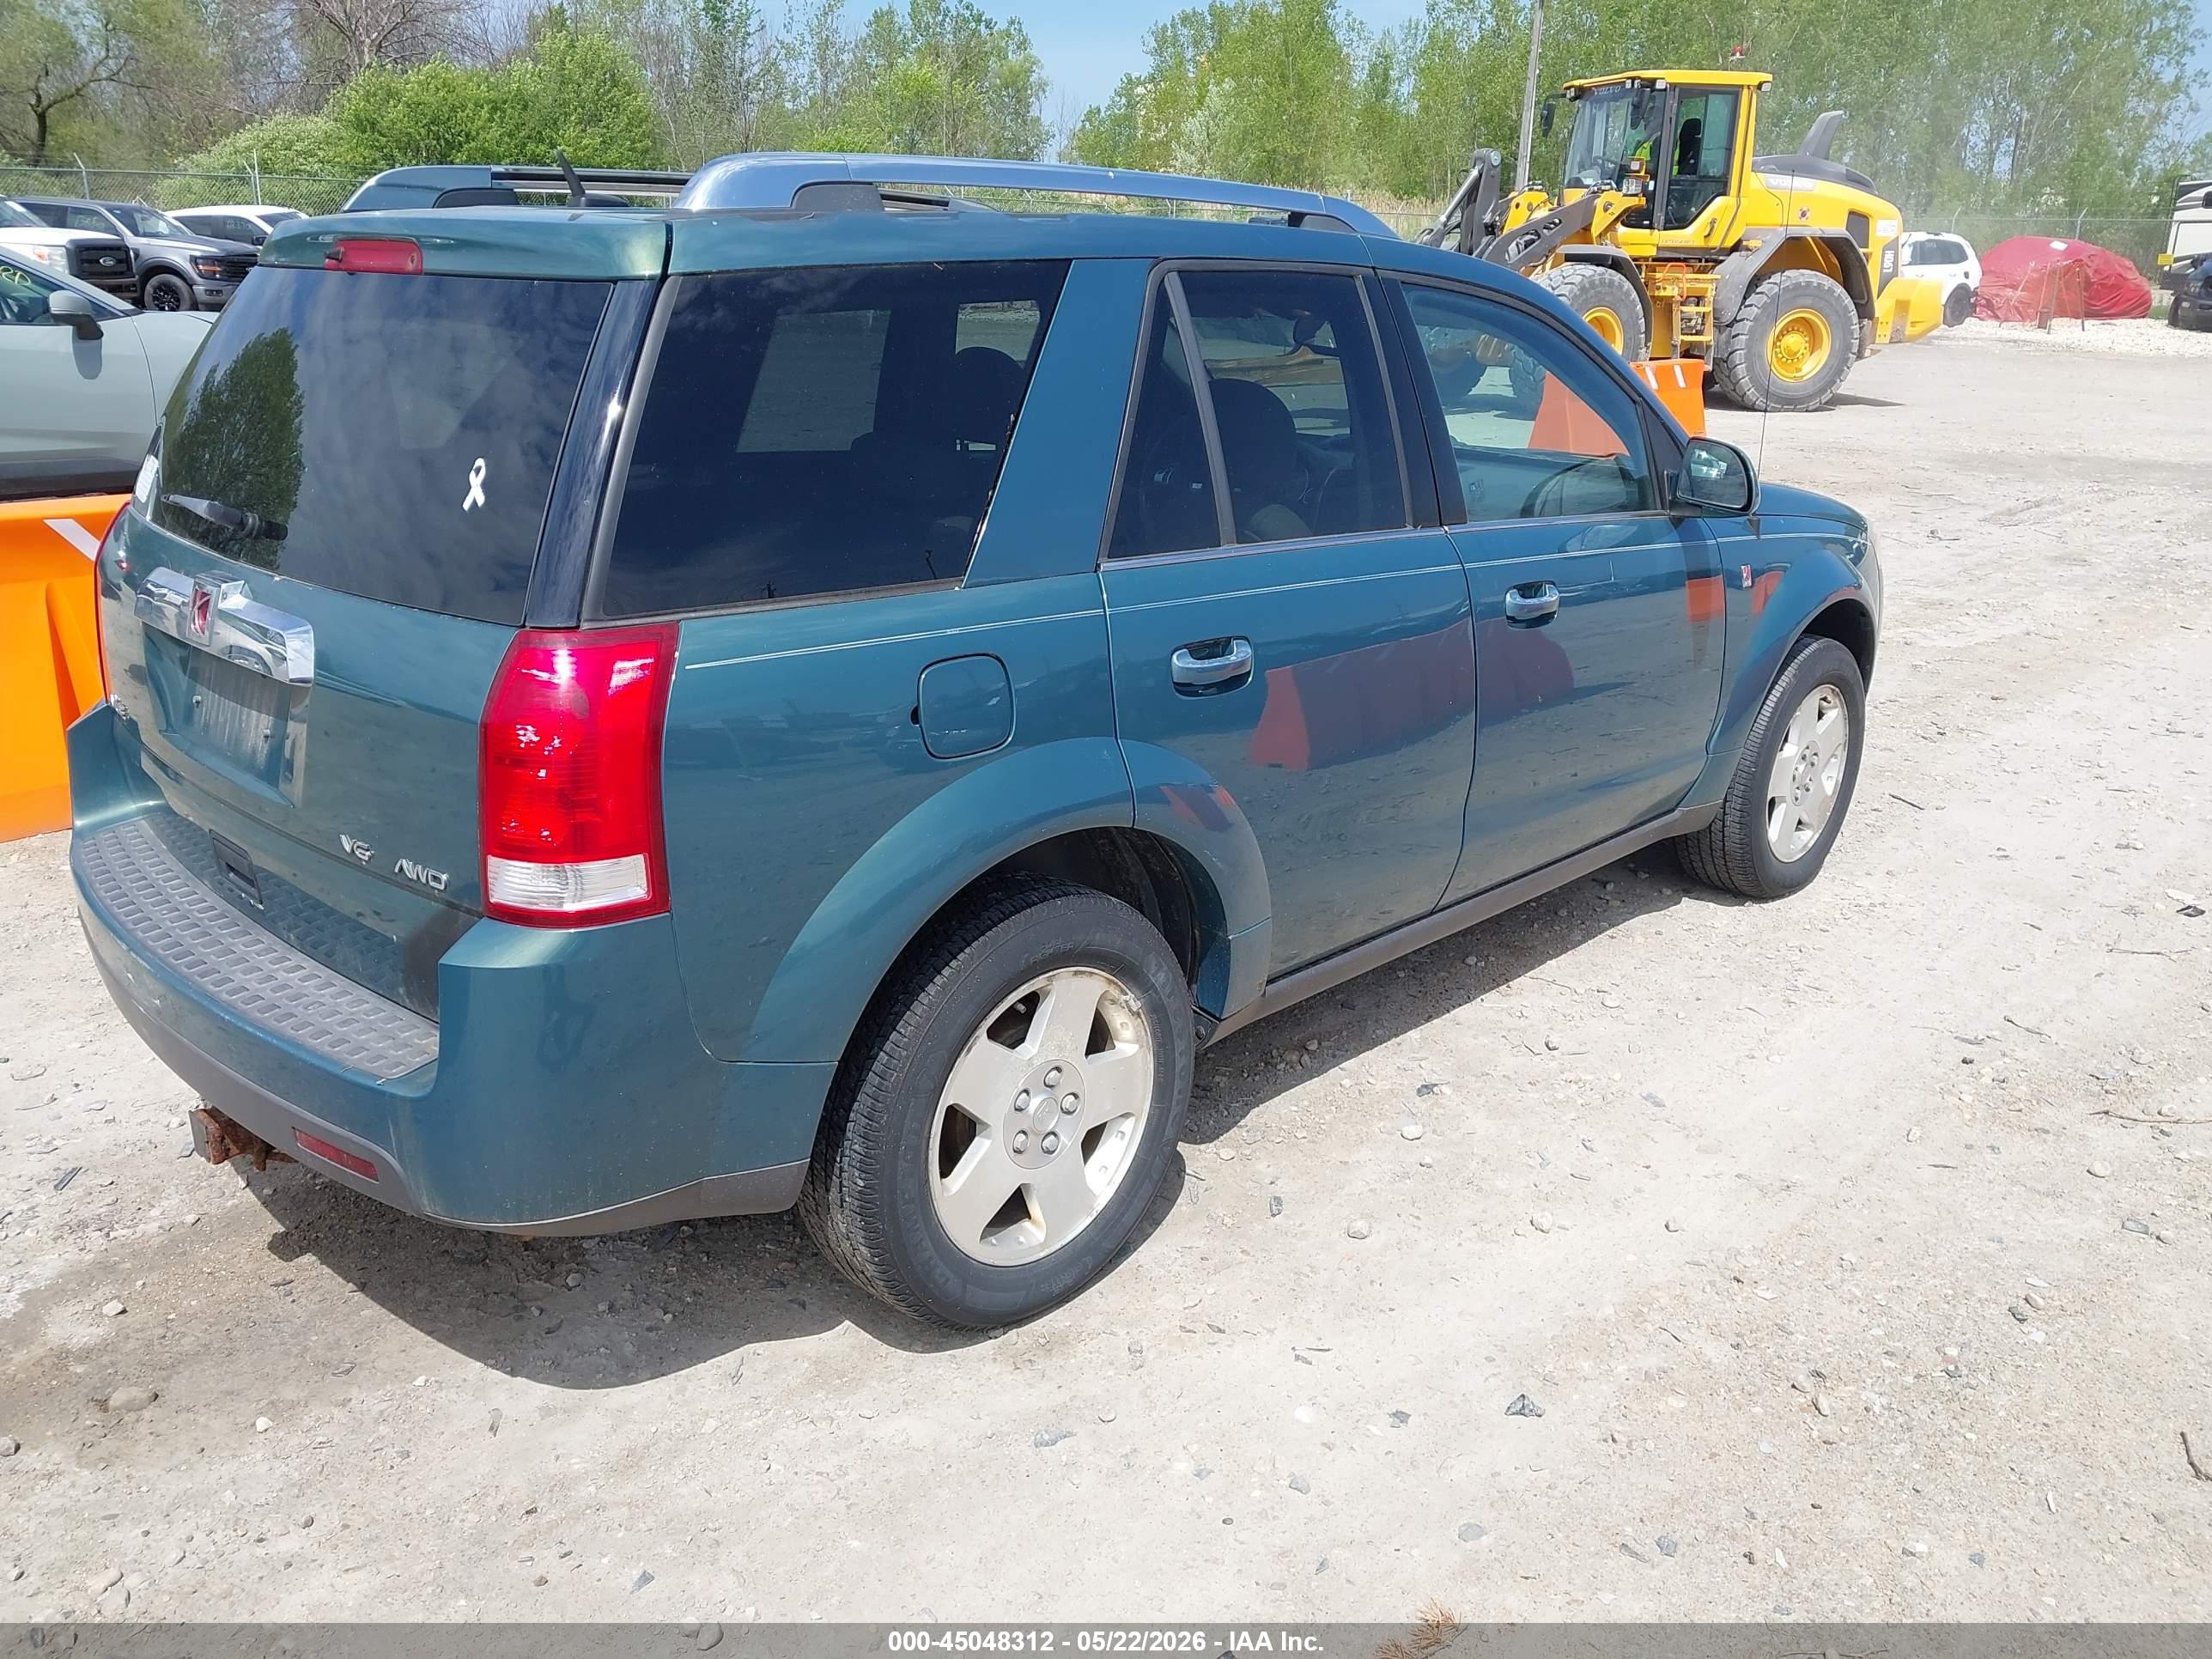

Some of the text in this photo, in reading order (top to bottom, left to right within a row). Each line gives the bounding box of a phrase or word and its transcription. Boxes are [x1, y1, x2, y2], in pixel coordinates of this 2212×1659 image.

[1592, 85, 1622, 95] VOLVO
[1883, 250, 1895, 273] L90H
[339, 834, 447, 890] V6 AWD
